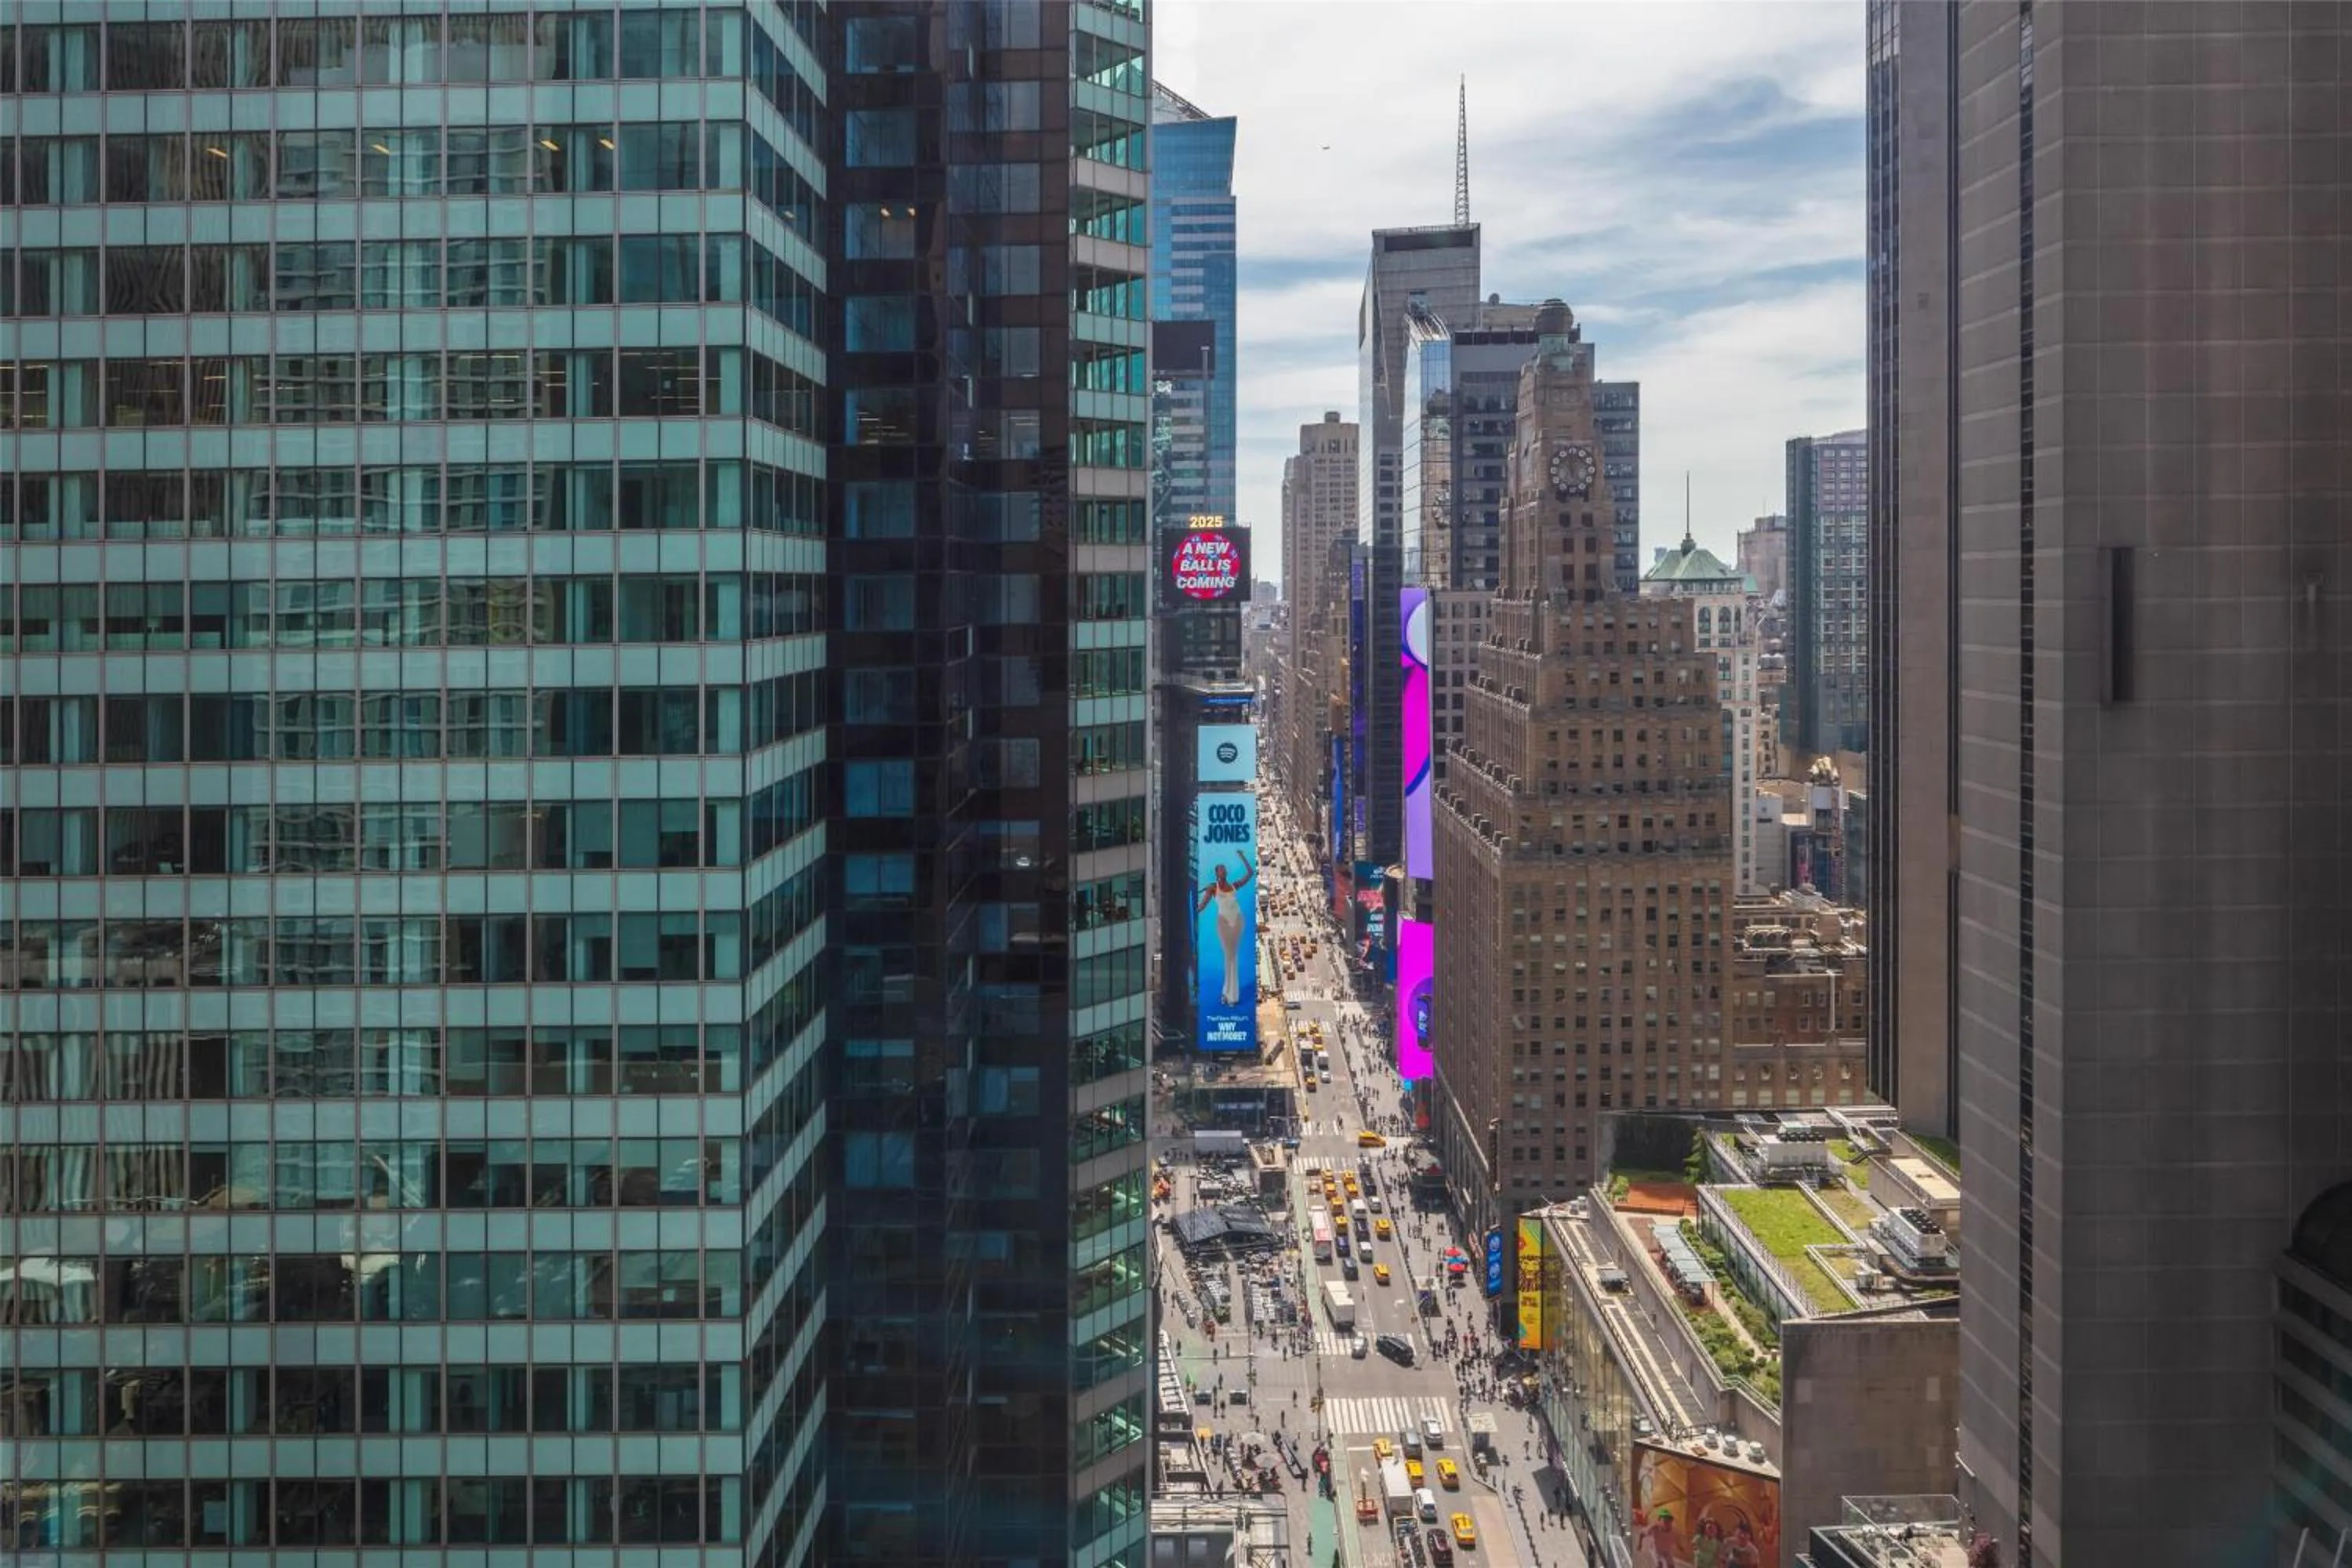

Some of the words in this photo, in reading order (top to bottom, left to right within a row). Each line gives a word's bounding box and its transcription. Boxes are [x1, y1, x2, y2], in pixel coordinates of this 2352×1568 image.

[1189, 515, 1223, 528] 2025
[1182, 543, 1193, 554] A
[1196, 542, 1230, 554] NEW
[1180, 559, 1214, 572] BALL
[1218, 559, 1232, 571] IS
[1177, 576, 1236, 589] COMING
[1208, 804, 1246, 823] COCO
[1203, 824, 1250, 844] JONES
[1218, 1022, 1236, 1032] WHY
